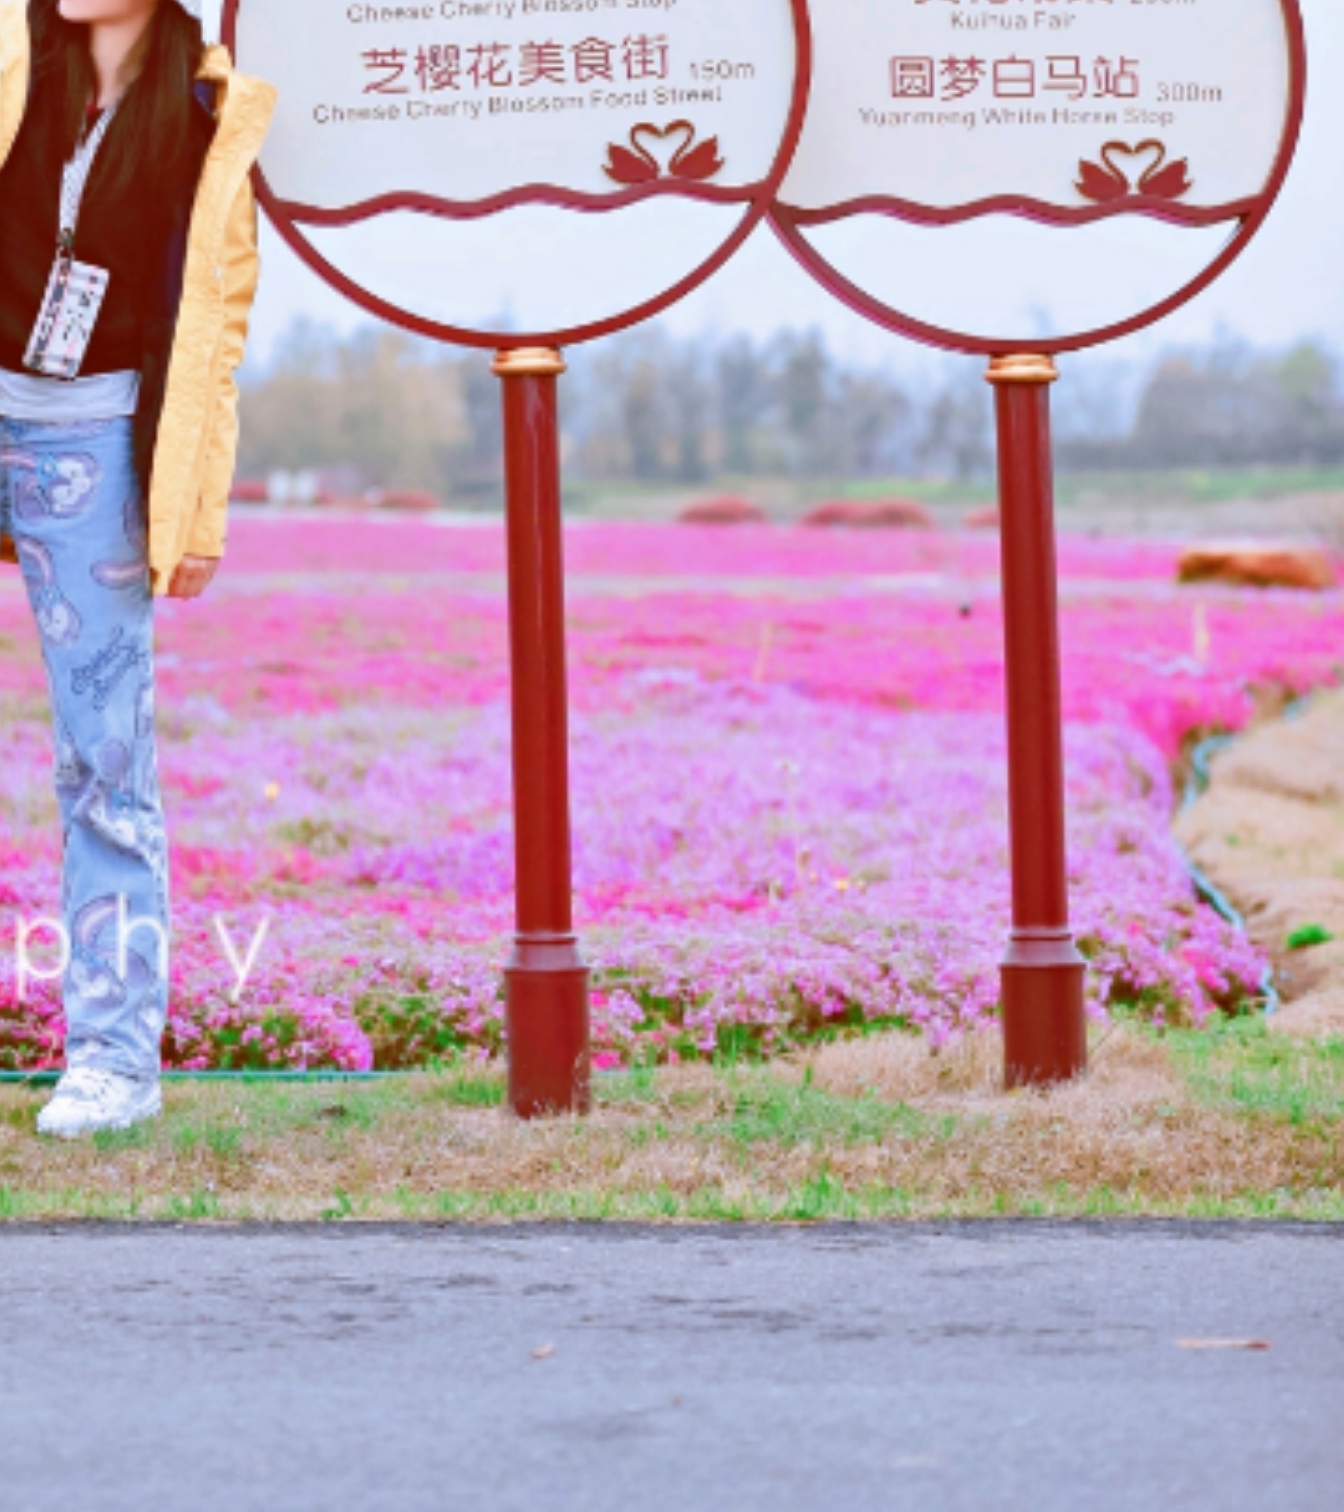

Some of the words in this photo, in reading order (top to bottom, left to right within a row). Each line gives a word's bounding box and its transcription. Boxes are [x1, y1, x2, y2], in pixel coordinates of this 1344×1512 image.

[347, 1, 434, 24] Cheese
[951, 11, 1028, 30] Kuihua
[1034, 11, 1077, 30] Fair
[360, 33, 670, 95] 芝樱花美食街
[689, 59, 755, 82] 150m
[889, 54, 1140, 101] 圆梦白马站
[1156, 82, 1223, 102] 300m
[313, 102, 400, 125] Cheese
[406, 99, 482, 122] Cherry
[488, 94, 584, 118] Blossom
[590, 89, 648, 110] Food
[656, 85, 722, 107] Street
[982, 107, 1047, 125] White
[1123, 107, 1176, 127] Stop
